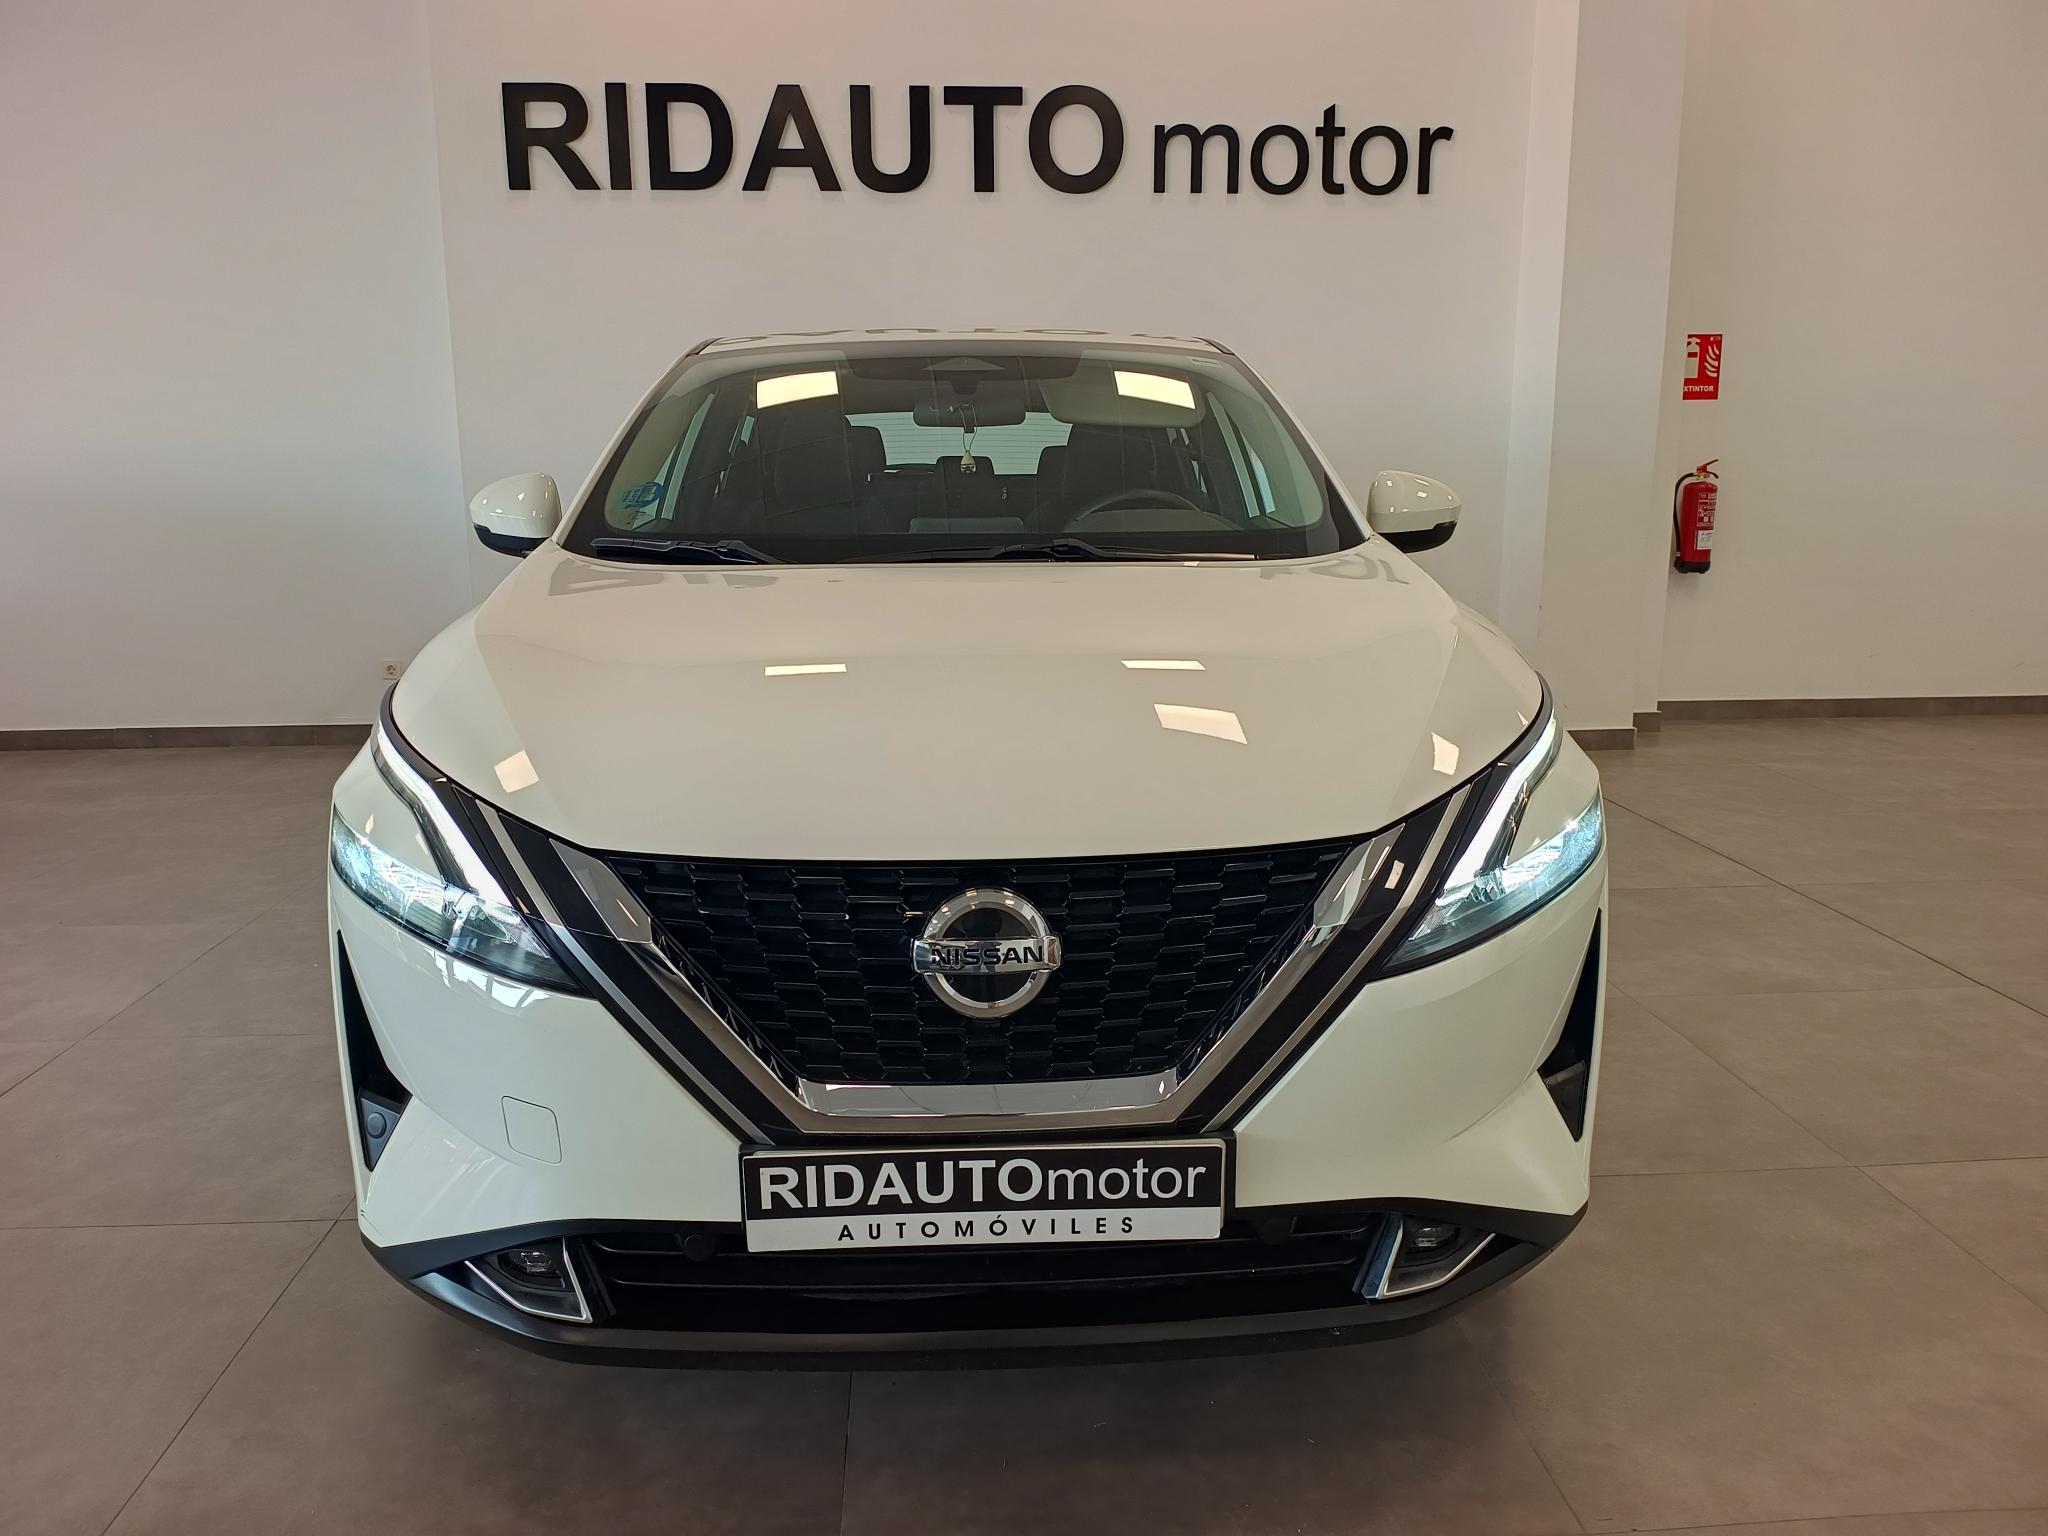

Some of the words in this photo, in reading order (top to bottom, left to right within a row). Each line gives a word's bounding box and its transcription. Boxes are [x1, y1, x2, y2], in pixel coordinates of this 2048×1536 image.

[501, 82, 1125, 194] RIDAUTO
[1153, 104, 1453, 196] motor
[931, 945, 1043, 966] NISSAN
[837, 1214, 1135, 1241] AUTOMÓVILES
